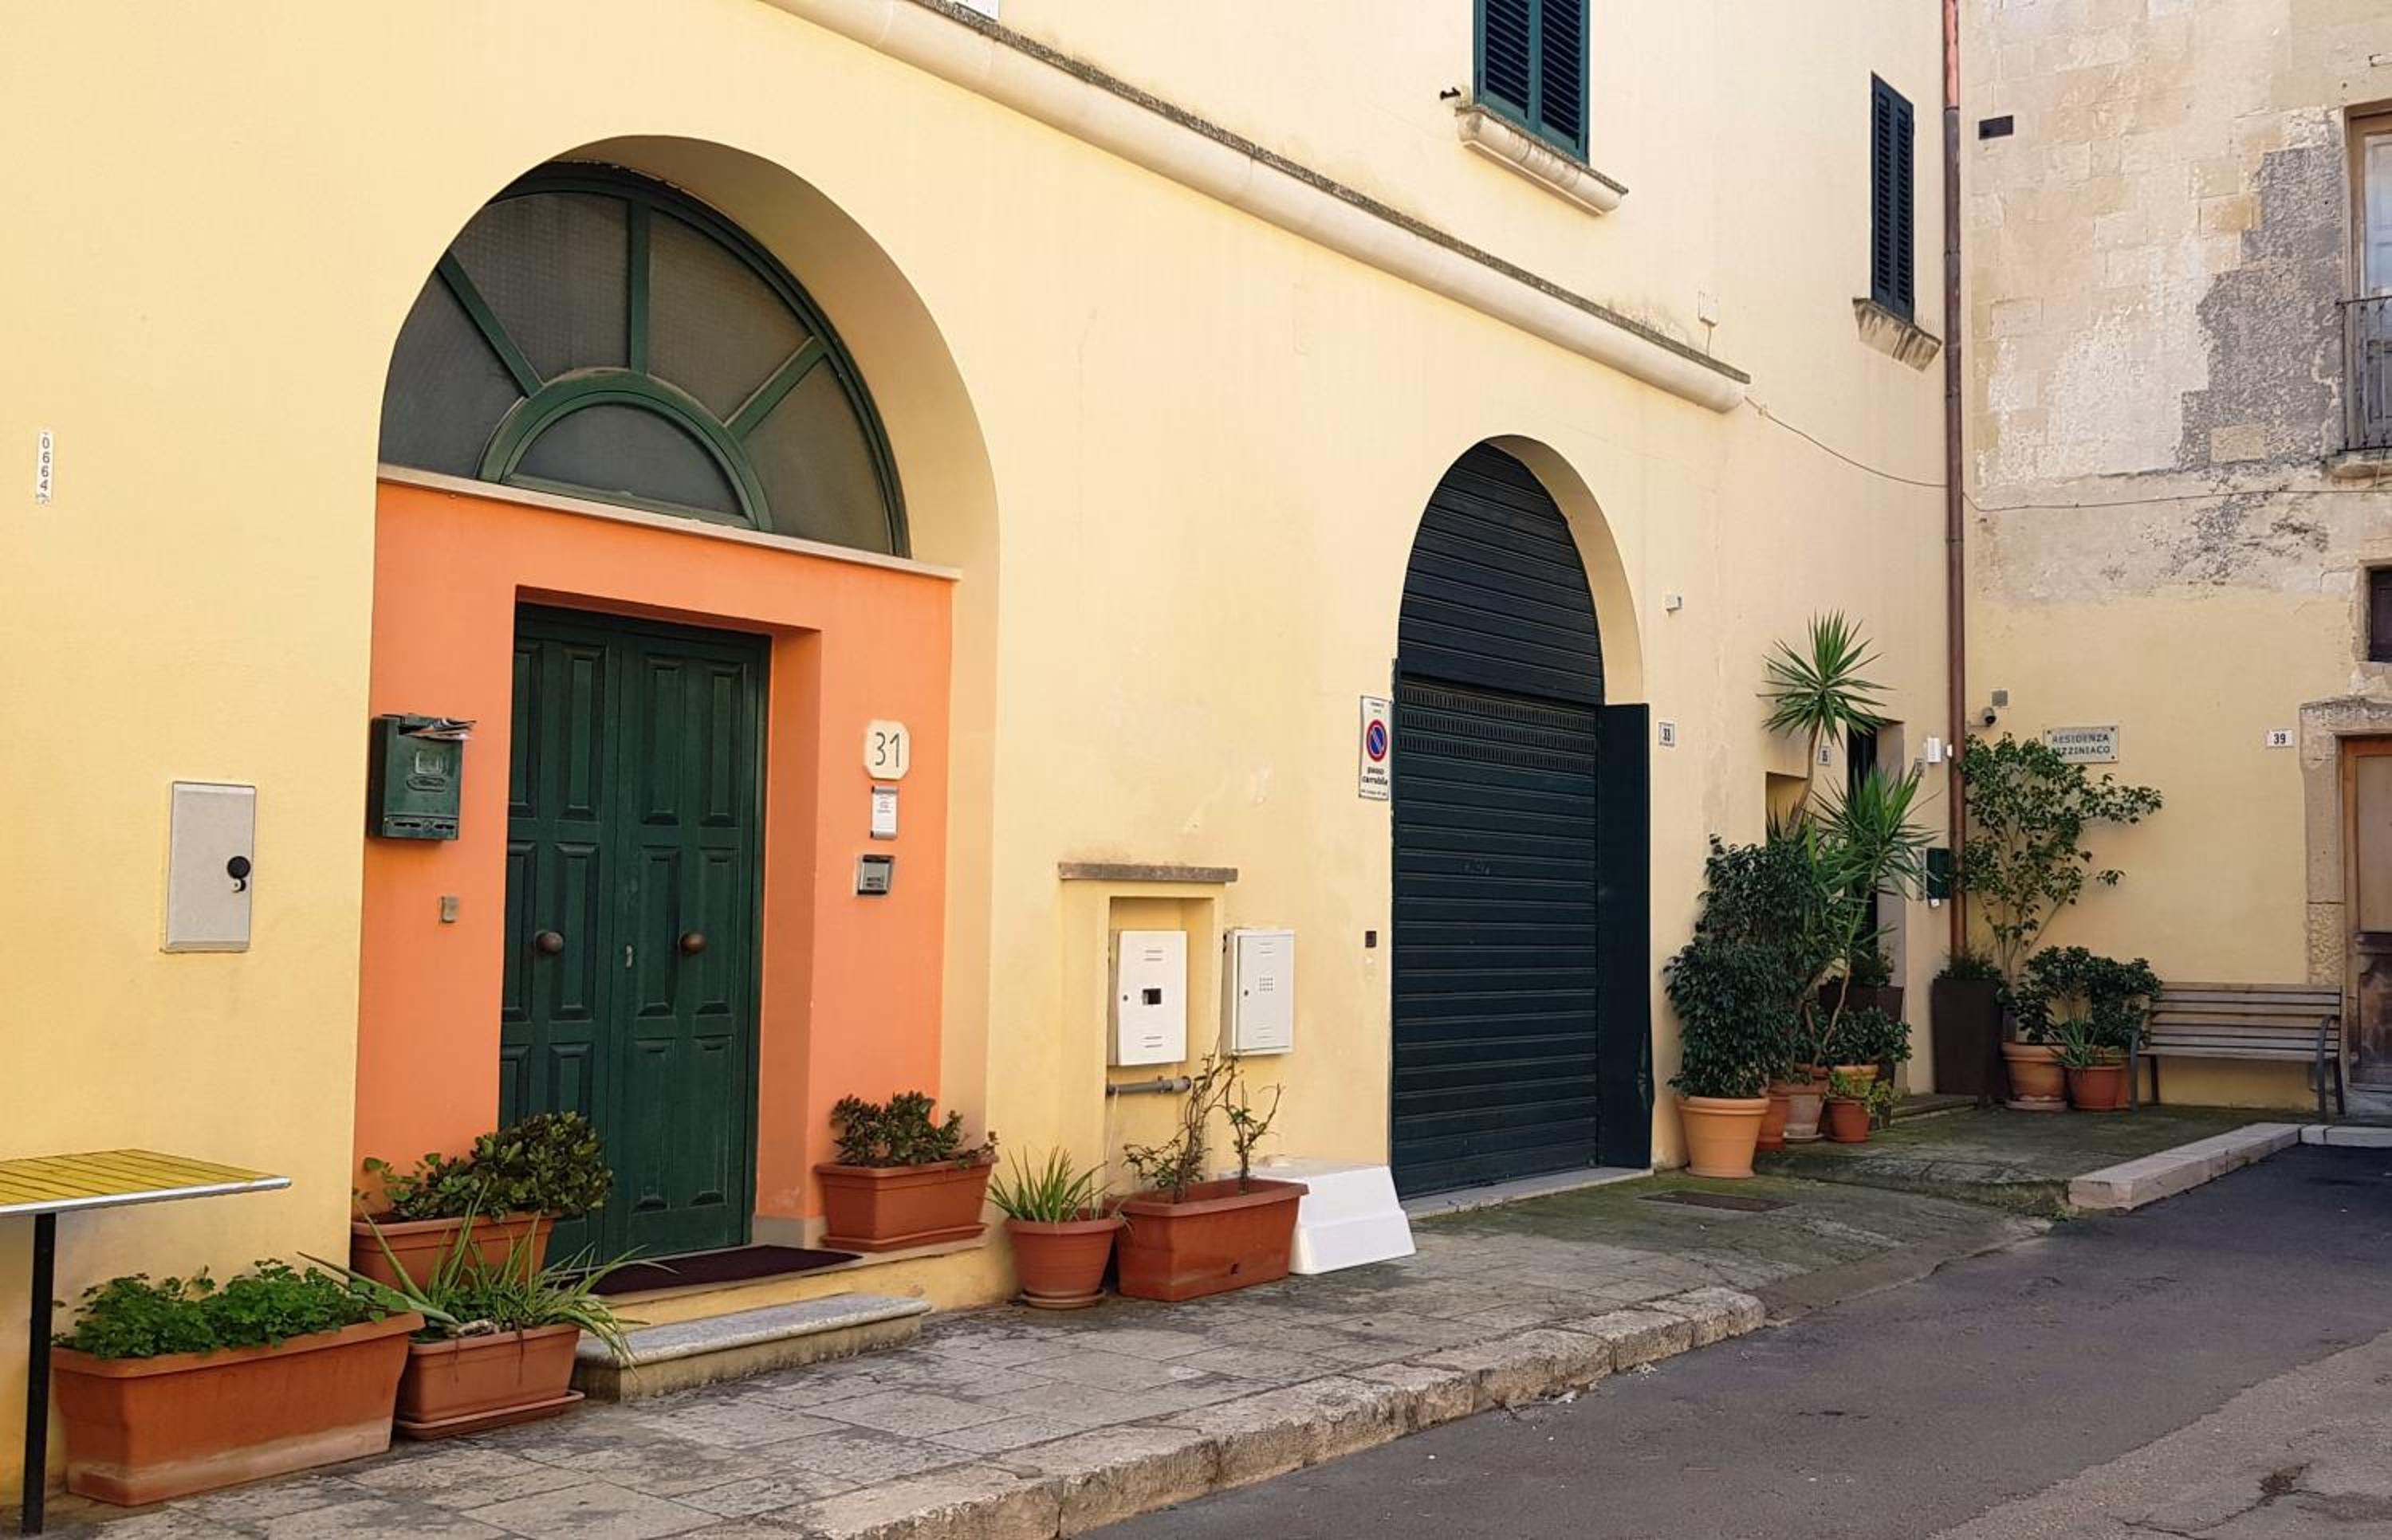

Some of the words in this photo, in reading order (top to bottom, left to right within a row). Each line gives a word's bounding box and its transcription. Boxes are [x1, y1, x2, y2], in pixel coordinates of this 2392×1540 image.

[2052, 733, 2110, 744] RESIDENZA
[2273, 733, 2286, 745] 39
[875, 732, 900, 768] 31
[2052, 745, 2111, 756] IZZINIACO
